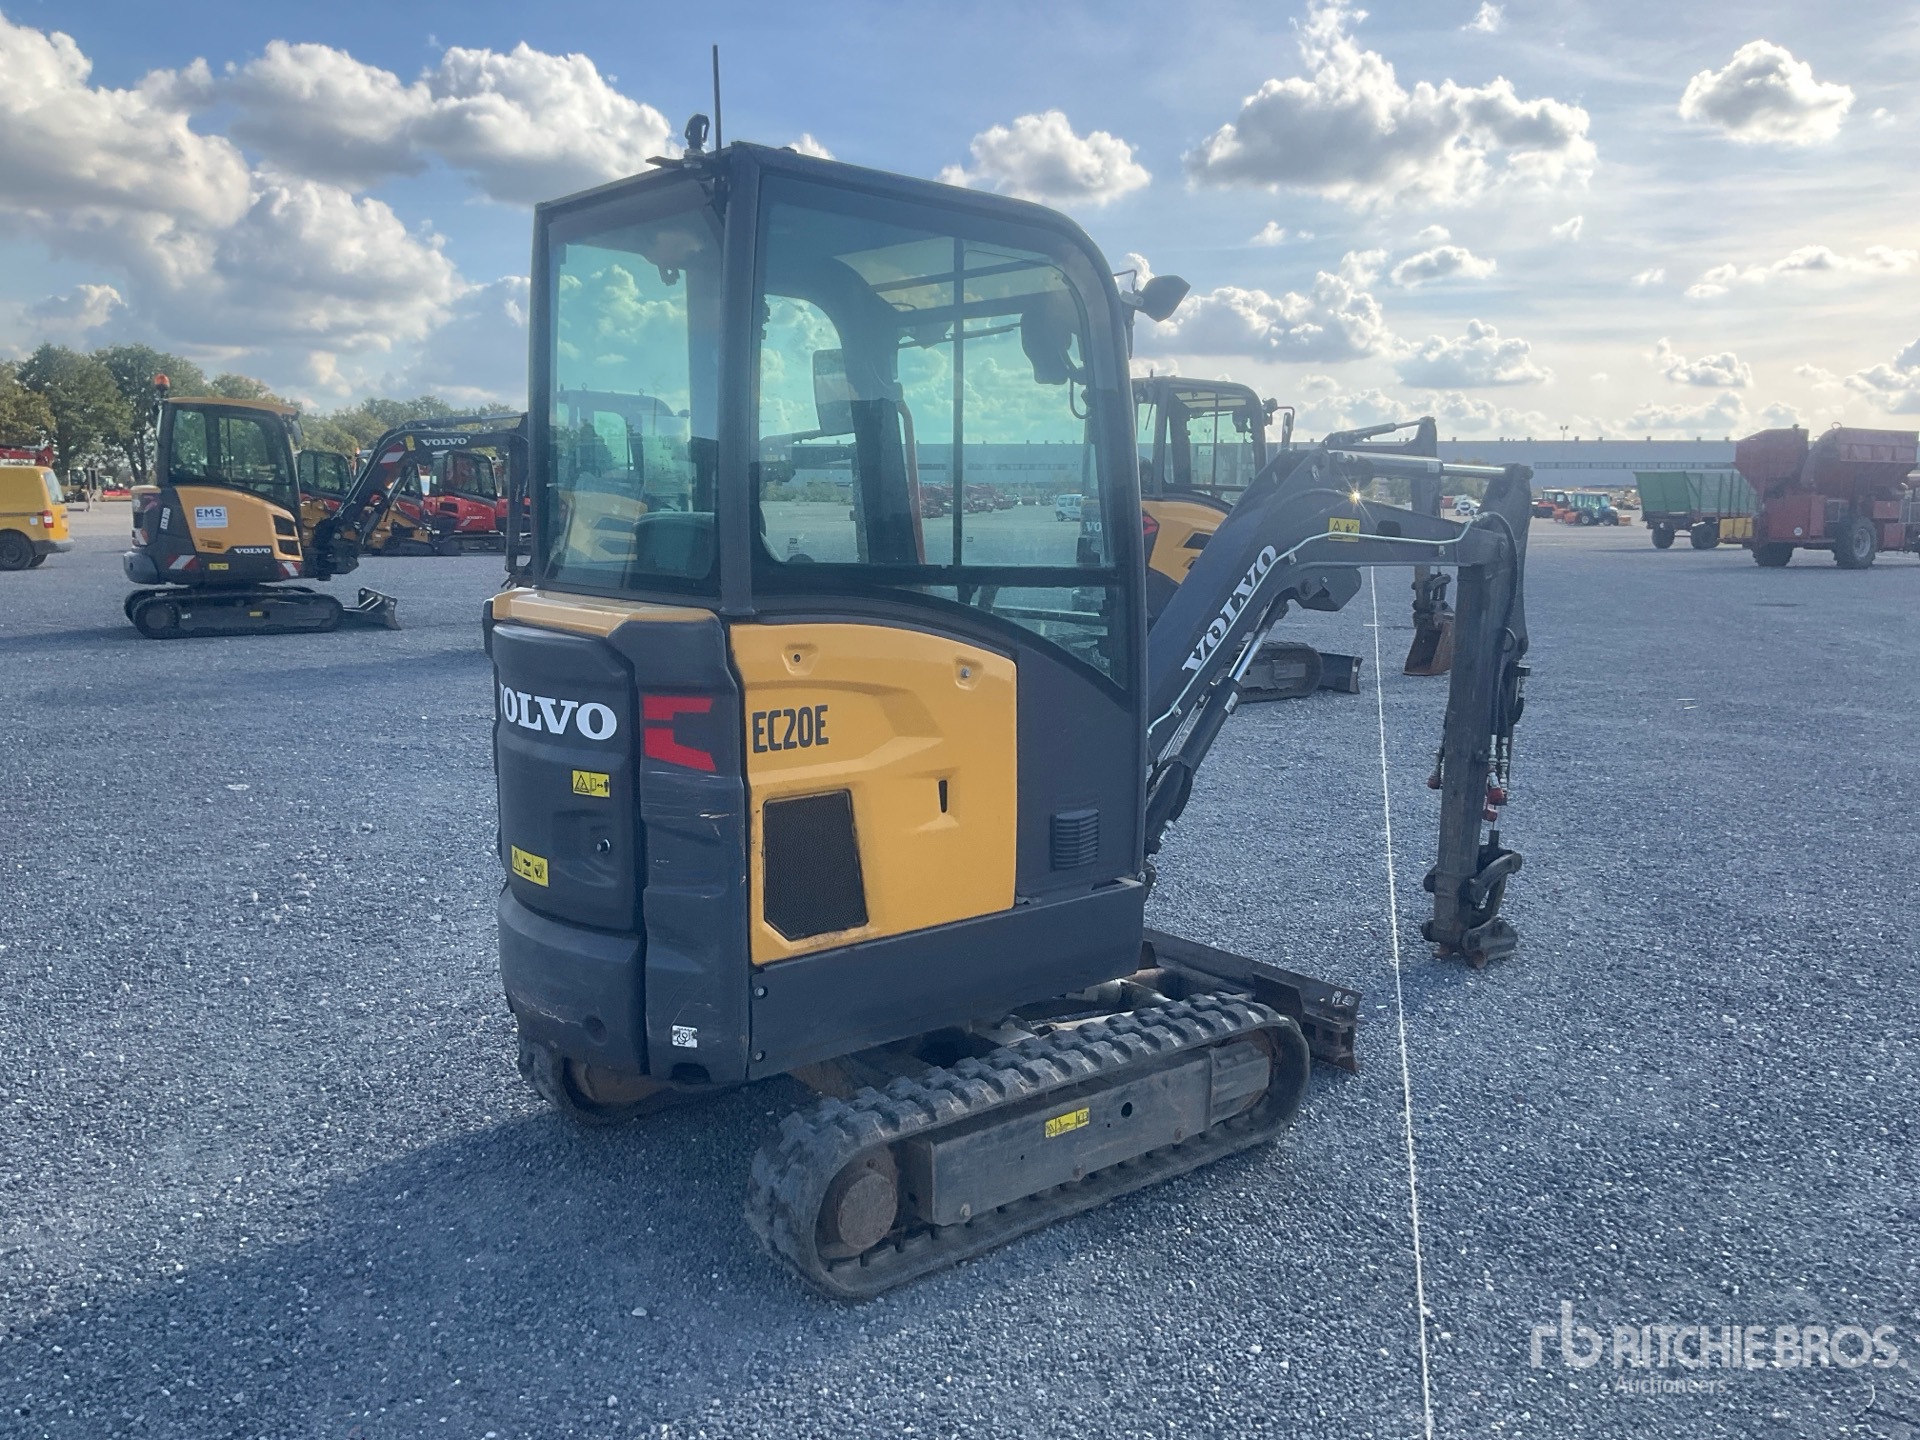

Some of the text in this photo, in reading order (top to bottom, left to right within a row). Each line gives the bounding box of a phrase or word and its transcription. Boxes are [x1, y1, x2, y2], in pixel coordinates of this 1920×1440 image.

[421, 438, 467, 446] VOLVO
[196, 508, 222, 518] EMS
[1181, 545, 1277, 671] VOLVO
[752, 704, 829, 753] EC20E
